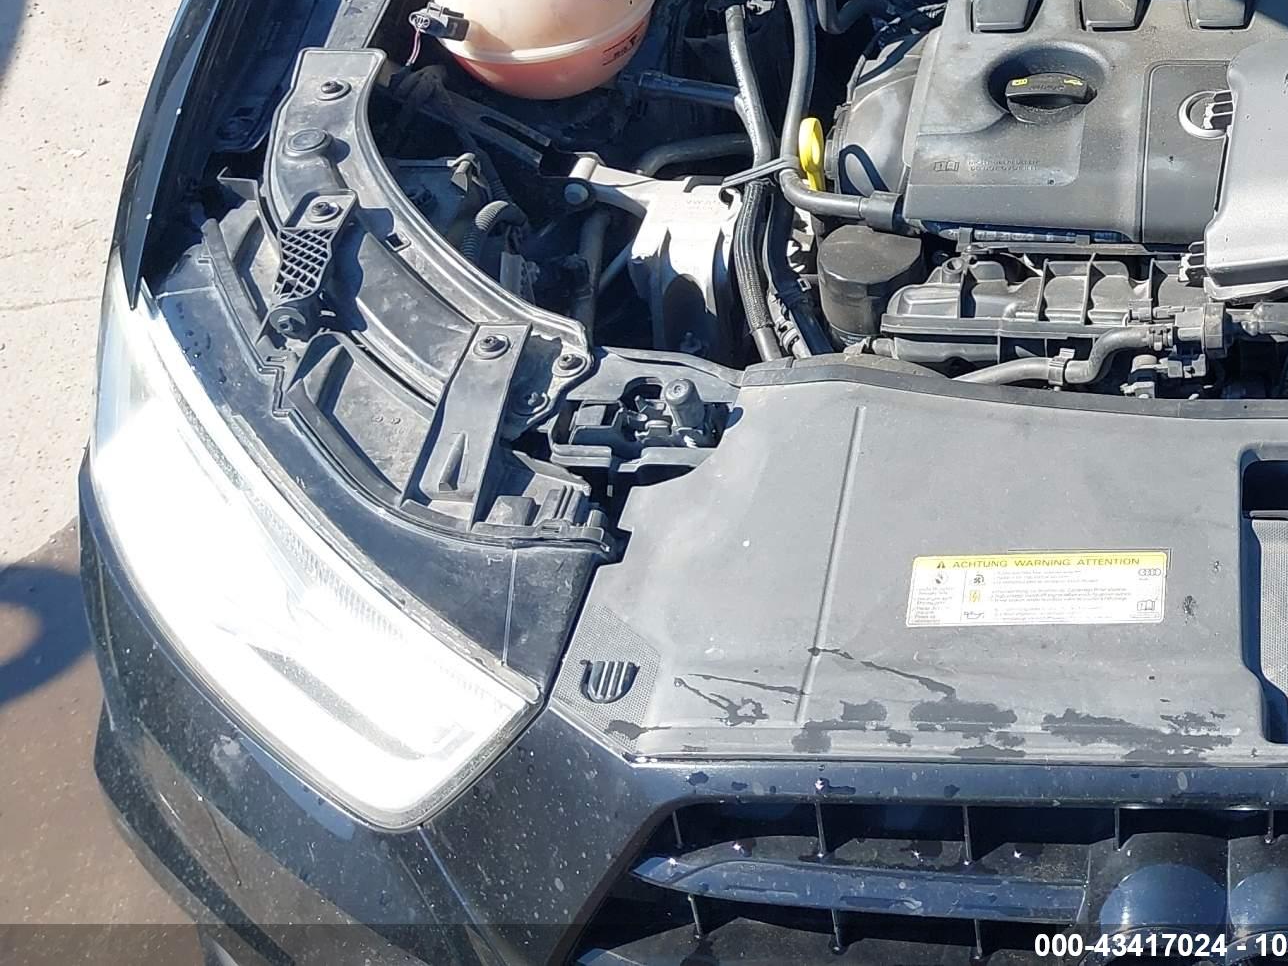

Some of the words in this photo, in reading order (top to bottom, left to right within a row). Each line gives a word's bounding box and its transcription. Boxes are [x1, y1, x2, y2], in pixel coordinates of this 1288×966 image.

[952, 560, 1008, 569] ACHTUNG
[1014, 559, 1071, 567] WARNING
[1077, 557, 1140, 566] ATTENTION
